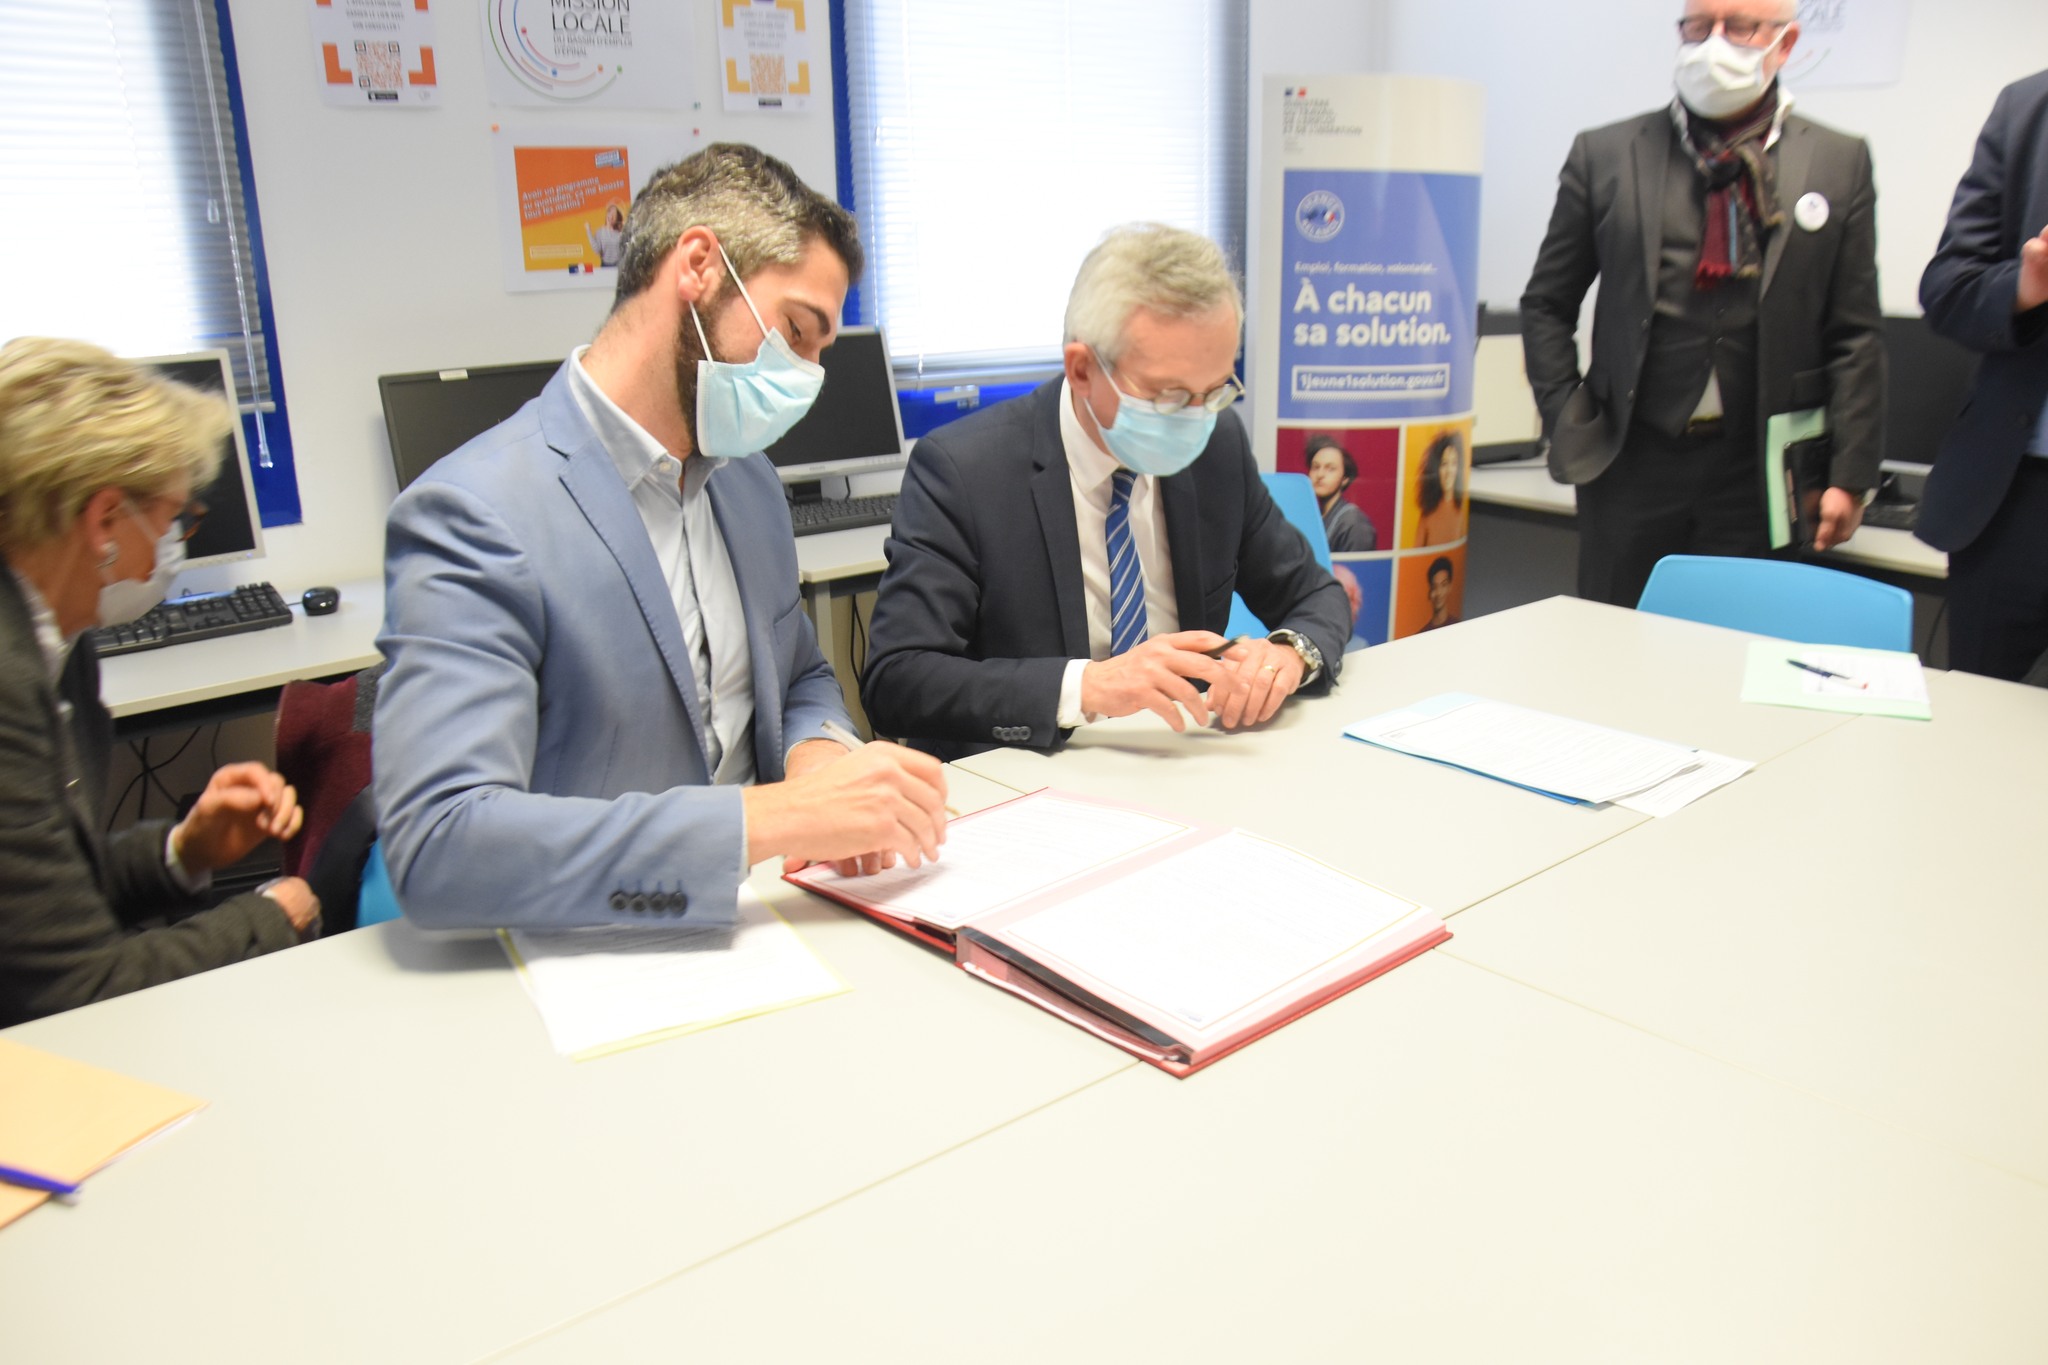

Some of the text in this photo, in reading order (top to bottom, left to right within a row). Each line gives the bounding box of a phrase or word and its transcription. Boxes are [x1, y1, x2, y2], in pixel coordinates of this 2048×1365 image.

[551, 11, 632, 33] LOCALE
[556, 177, 599, 194] programme
[1333, 261, 1385, 275] formation,
[1293, 276, 1432, 315] À chacun
[1293, 315, 1452, 348] sa solution.
